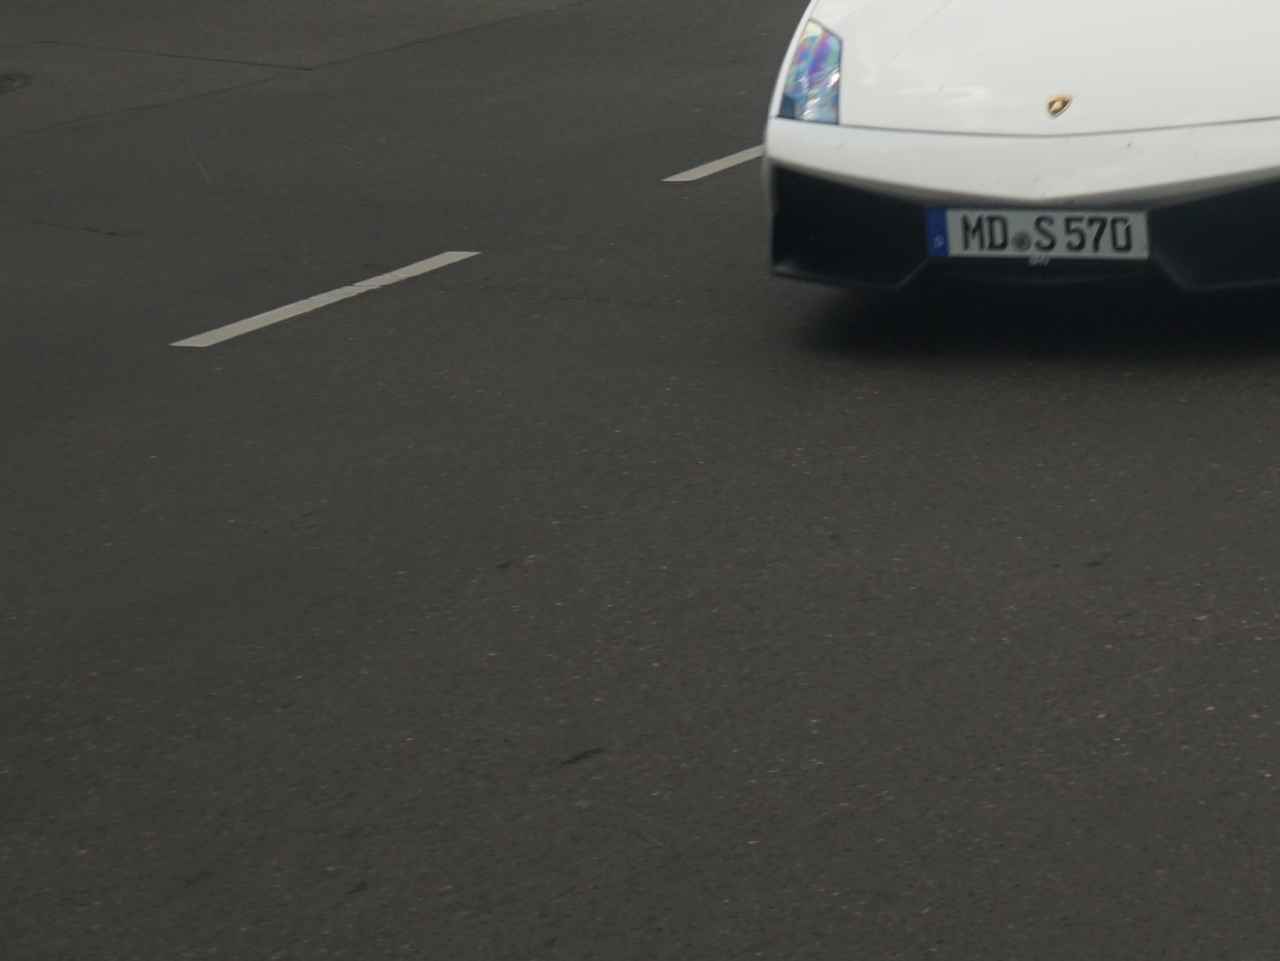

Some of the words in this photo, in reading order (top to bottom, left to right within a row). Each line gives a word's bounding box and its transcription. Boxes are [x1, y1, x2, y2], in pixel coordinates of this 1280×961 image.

[961, 213, 1009, 252] MD
[1033, 214, 1056, 252] S
[1063, 214, 1133, 254] 570
